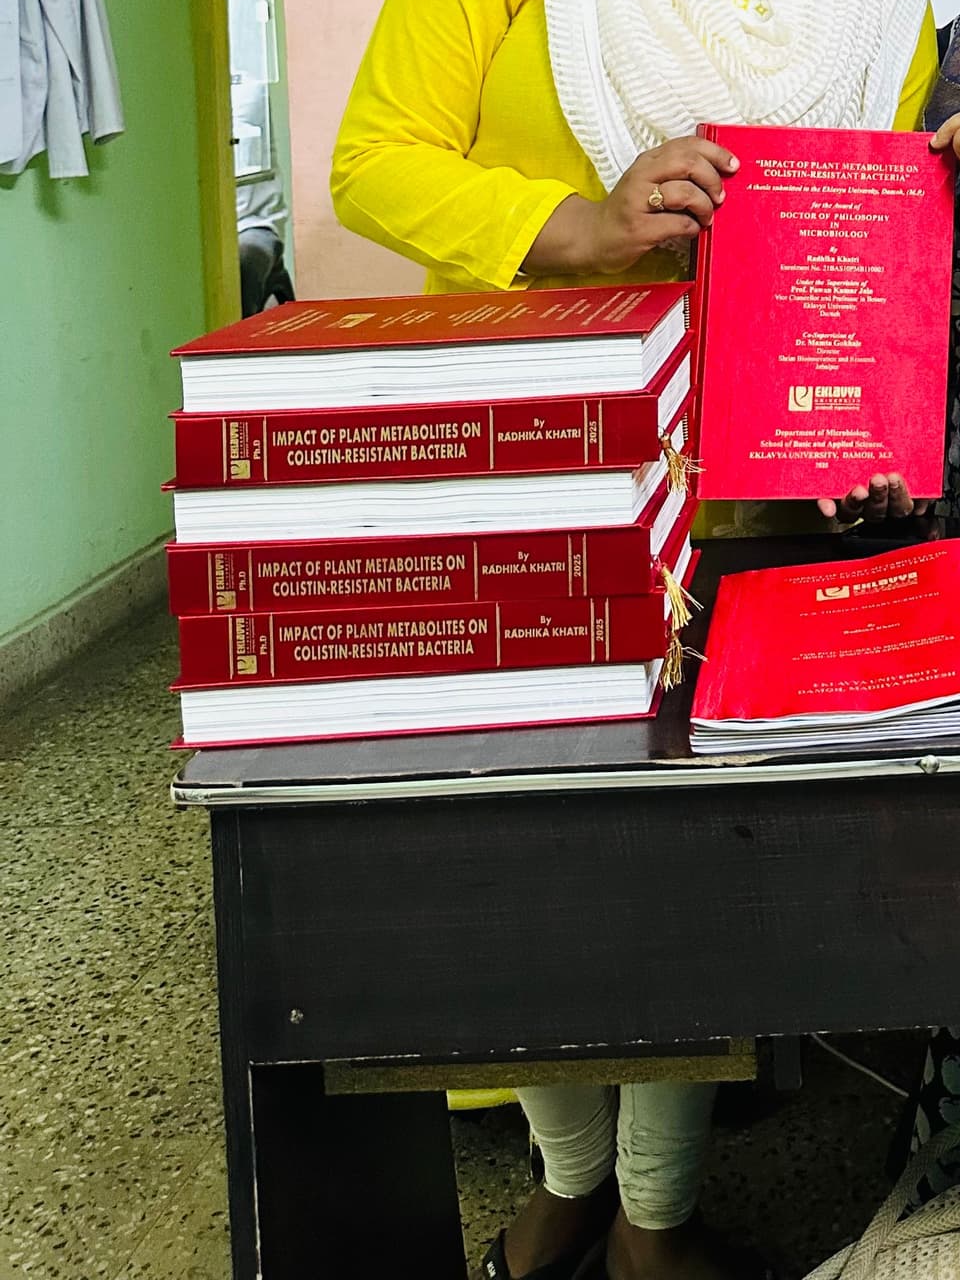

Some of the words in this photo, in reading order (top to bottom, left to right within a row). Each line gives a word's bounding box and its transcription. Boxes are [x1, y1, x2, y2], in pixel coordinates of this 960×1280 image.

[756, 160, 794, 168] "IMPACT
[810, 162, 840, 170] PLANT
[842, 163, 904, 172] METABOLITES
[764, 169, 858, 180] COLISTIN-RESISTANT
[860, 172, 910, 182] BACTERIA"
[780, 212, 816, 220] DOCTOR
[818, 212, 830, 220] OF
[834, 214, 889, 222] PHILOSOPHY
[800, 230, 869, 238] MICROBIOLOGY
[534, 418, 545, 428] By
[272, 429, 317, 447] IMPACT
[320, 428, 336, 445] OF
[339, 426, 377, 443] PLANT
[380, 423, 458, 442] METABOLITES
[462, 422, 481, 438] ON
[497, 430, 543, 442] RADHIKA
[546, 428, 581, 440] KHATRI
[589, 420, 597, 444] 2025
[775, 428, 816, 436] Department
[760, 440, 783, 448] School
[784, 440, 792, 448] of
[827, 441, 854, 449] Applied
[287, 446, 407, 466] COLISTIN-RESISTANT
[410, 443, 467, 461] BACTERIA
[750, 451, 787, 459] EKLAVYA
[518, 552, 529, 562] By
[258, 561, 302, 578] IMPACT
[305, 560, 322, 576] OF
[325, 559, 362, 575] PLANT
[365, 555, 443, 574] METABOLITES
[446, 555, 465, 570] ON
[482, 564, 527, 575] RADHIKA
[530, 562, 566, 573] KHATRI
[573, 554, 581, 577] 2025
[273, 578, 392, 597] COLISTIN-RESISTANT
[396, 575, 451, 592] BACTERIA
[540, 616, 552, 626] By
[279, 625, 323, 642] IMPACT
[327, 624, 343, 640] OF
[346, 623, 383, 639] PLANT
[387, 620, 465, 638] METABOLITES
[469, 619, 488, 635] ON
[504, 628, 549, 639] RADHIKA
[552, 626, 588, 637] KHATRI
[596, 618, 604, 642] 2025
[294, 642, 414, 661] COLISTIN-RESISTANT
[418, 640, 474, 657] BACTERIA
